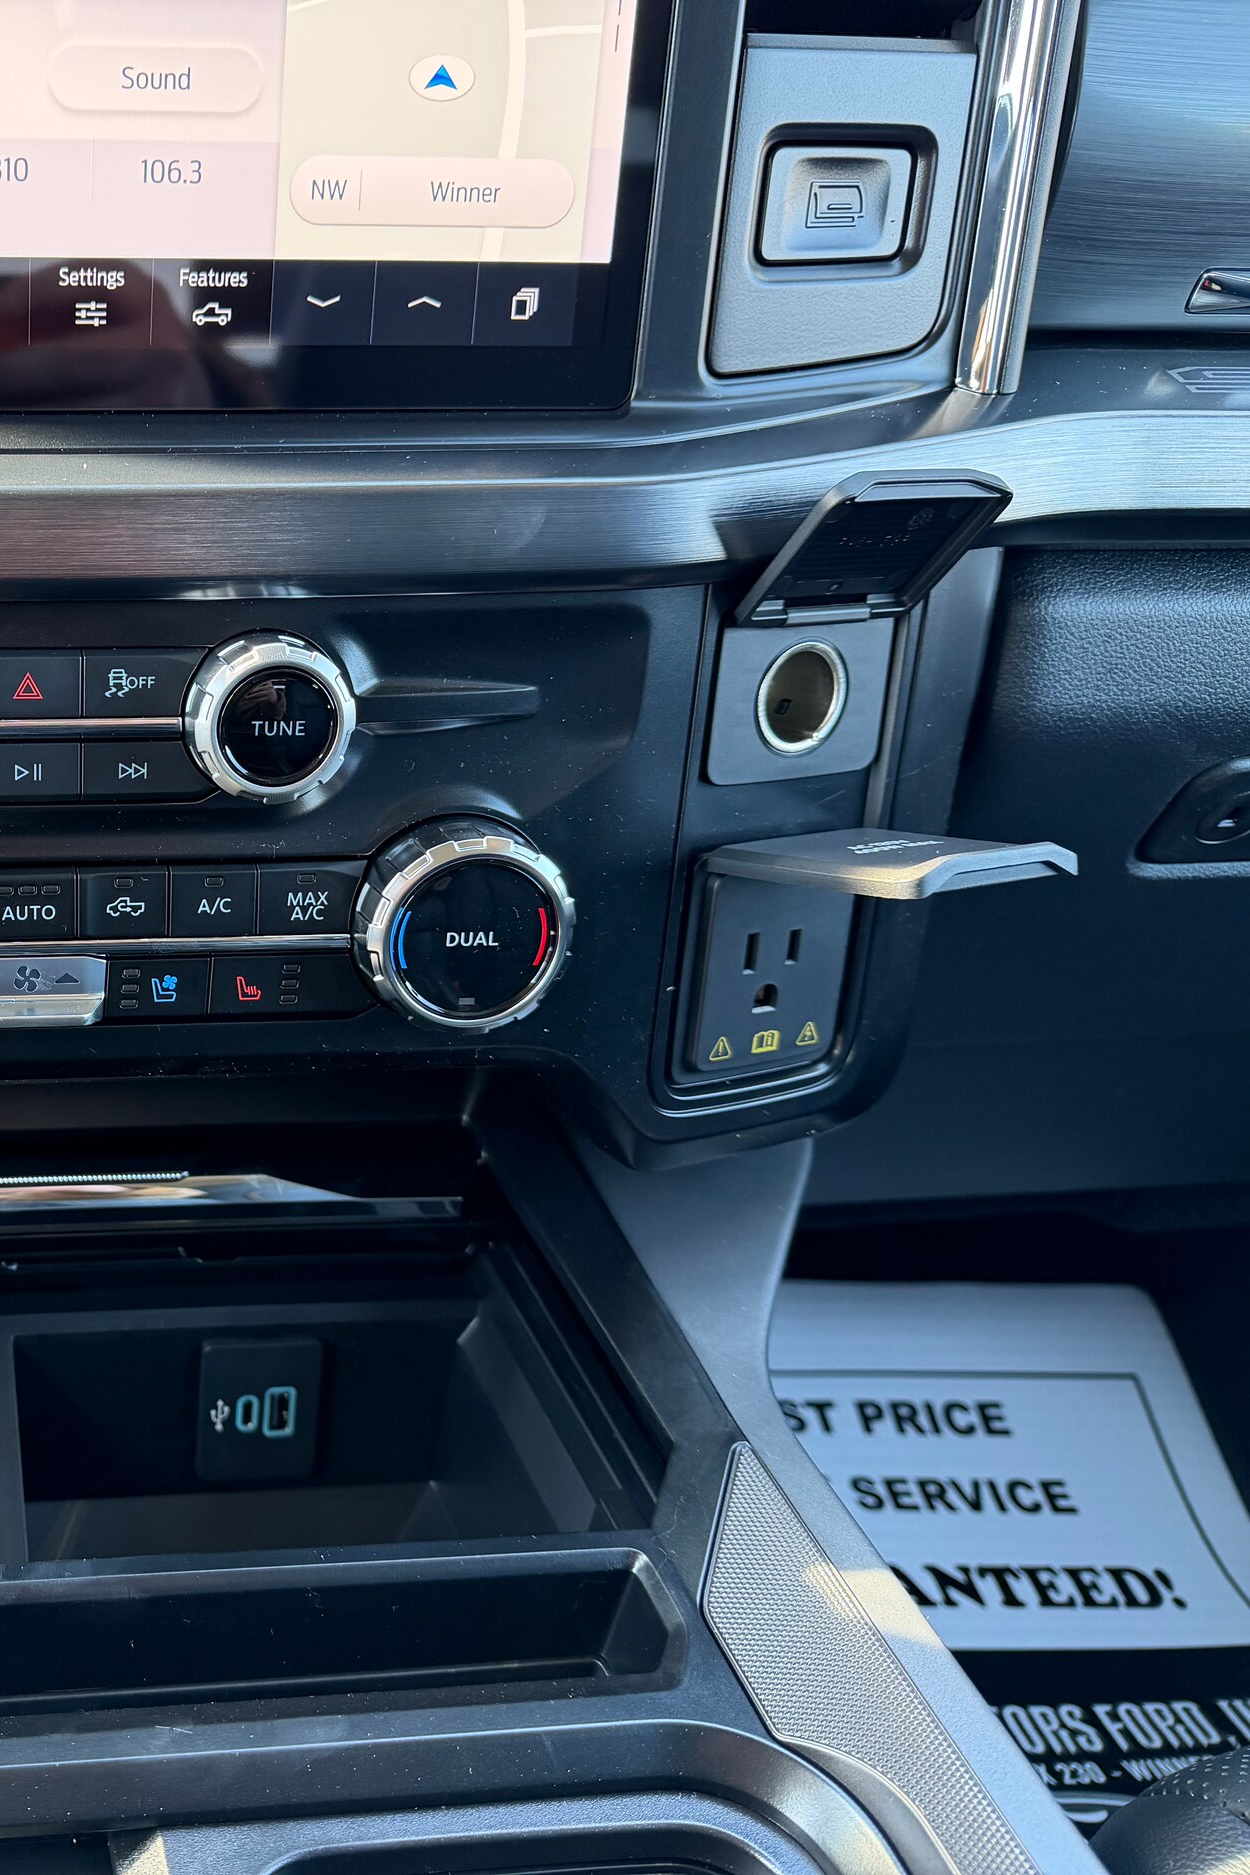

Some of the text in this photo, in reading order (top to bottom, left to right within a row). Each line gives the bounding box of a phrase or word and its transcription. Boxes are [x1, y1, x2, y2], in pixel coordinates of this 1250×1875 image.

[120, 65, 192, 91] Sound
[140, 158, 203, 185] 106.3
[310, 179, 347, 202] NW
[430, 180, 501, 205] Winner
[58, 267, 125, 290] Settings
[178, 268, 248, 289] Features
[126, 673, 156, 691] OFF
[251, 720, 306, 737] TUNE
[197, 897, 232, 916] A/C
[286, 891, 329, 907] MAX
[1, 904, 56, 922] AUTO
[290, 904, 324, 923] A/C
[445, 931, 499, 948] DUAL
[856, 1400, 1011, 1436] PRICE
[853, 1476, 1078, 1515] SERVICE
[994, 1701, 1105, 1755] ORS
[1053, 1761, 1108, 1786] 230
[1120, 1755, 1214, 1784] WINN
